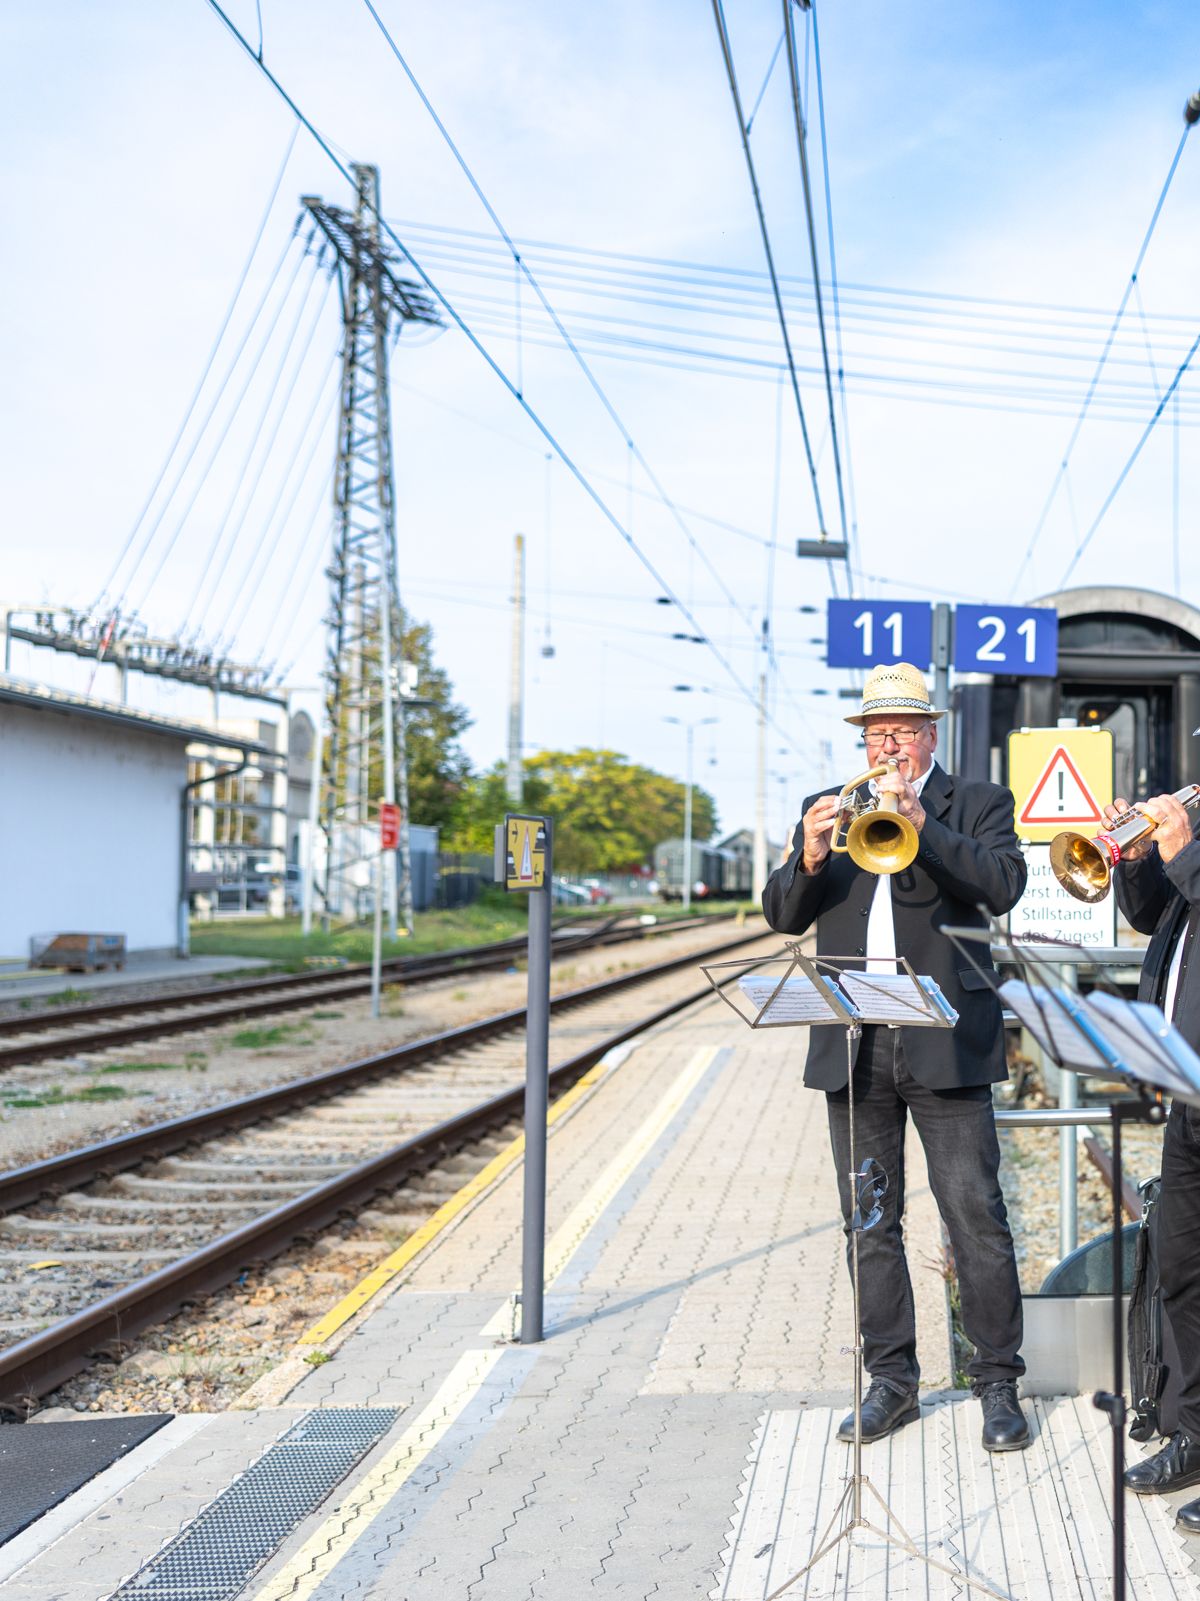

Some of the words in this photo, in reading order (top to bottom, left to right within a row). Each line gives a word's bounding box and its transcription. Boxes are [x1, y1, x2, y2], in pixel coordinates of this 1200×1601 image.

[853, 611, 902, 657] 11
[976, 616, 1036, 663] 21
[1022, 907, 1092, 921] Stillstand
[1022, 929, 1048, 943] des
[1054, 929, 1104, 946] Zuges!
